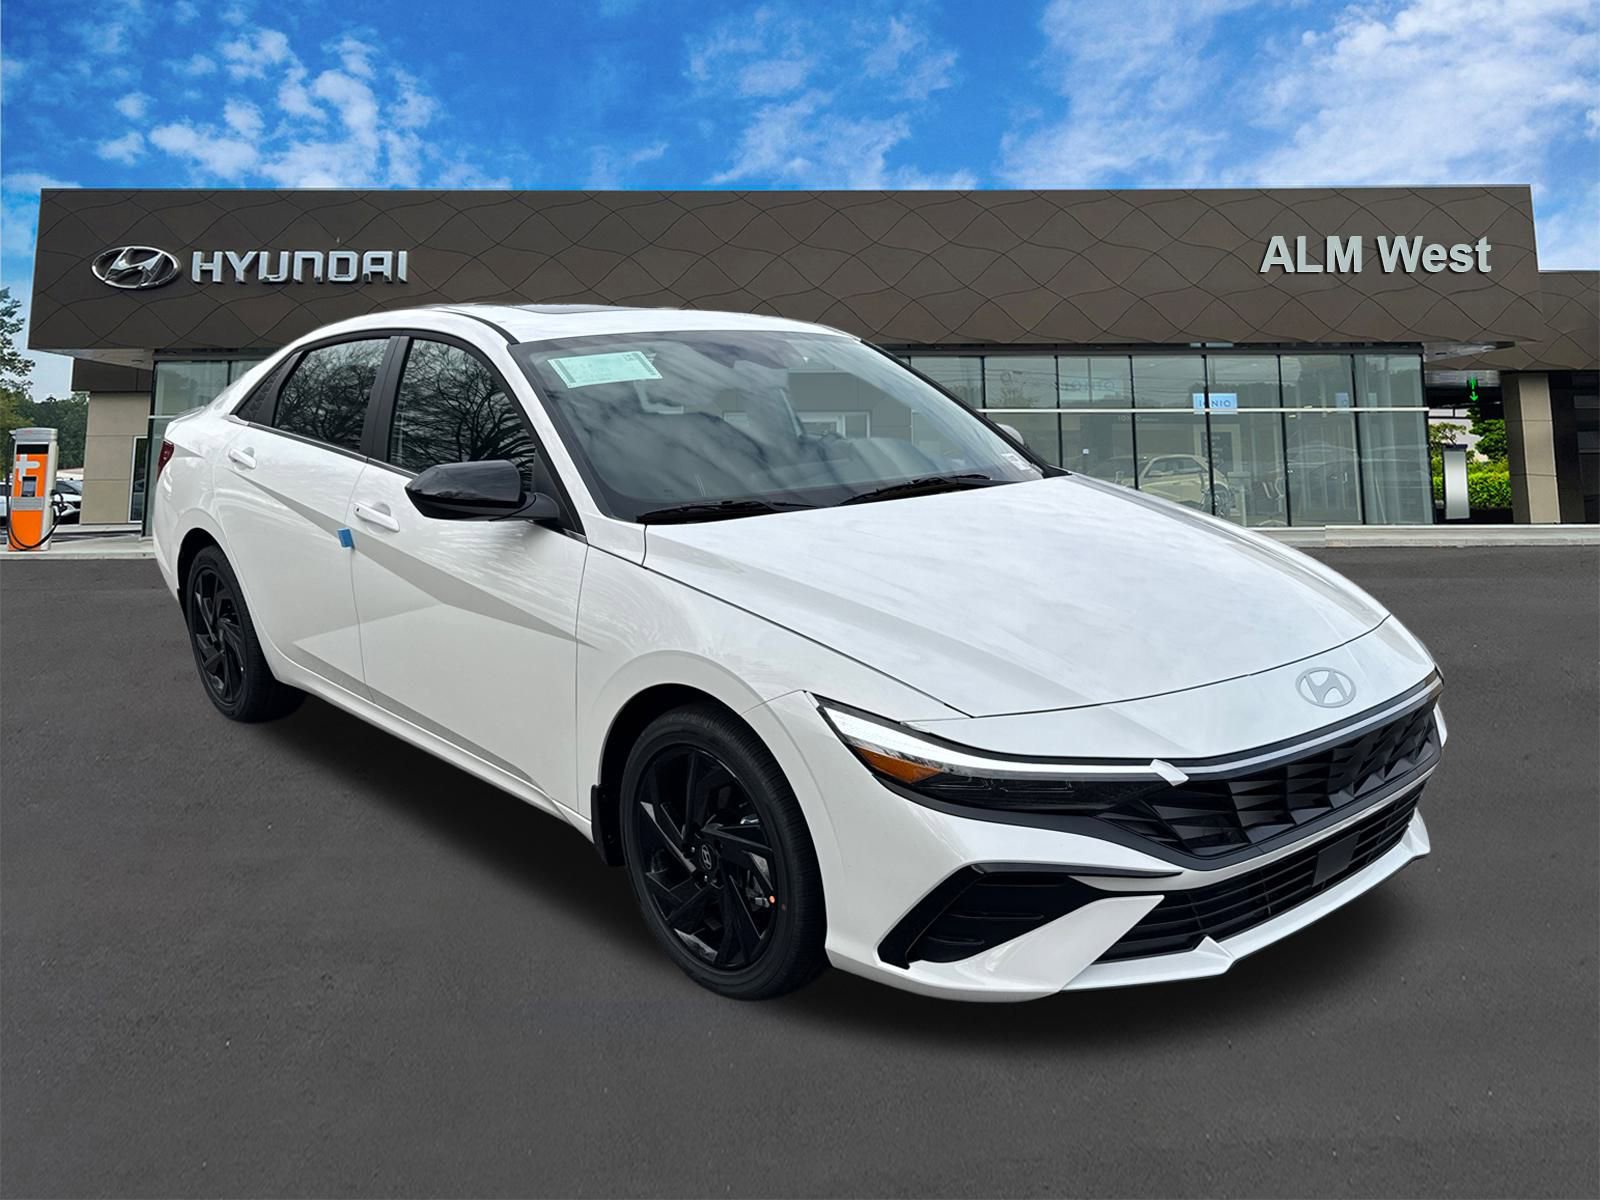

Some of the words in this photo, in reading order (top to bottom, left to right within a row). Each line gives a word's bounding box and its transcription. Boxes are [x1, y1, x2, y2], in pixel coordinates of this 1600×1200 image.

[191, 251, 409, 284] HYUNDAI
[1260, 235, 1363, 273] ALM
[1377, 235, 1492, 273] West
